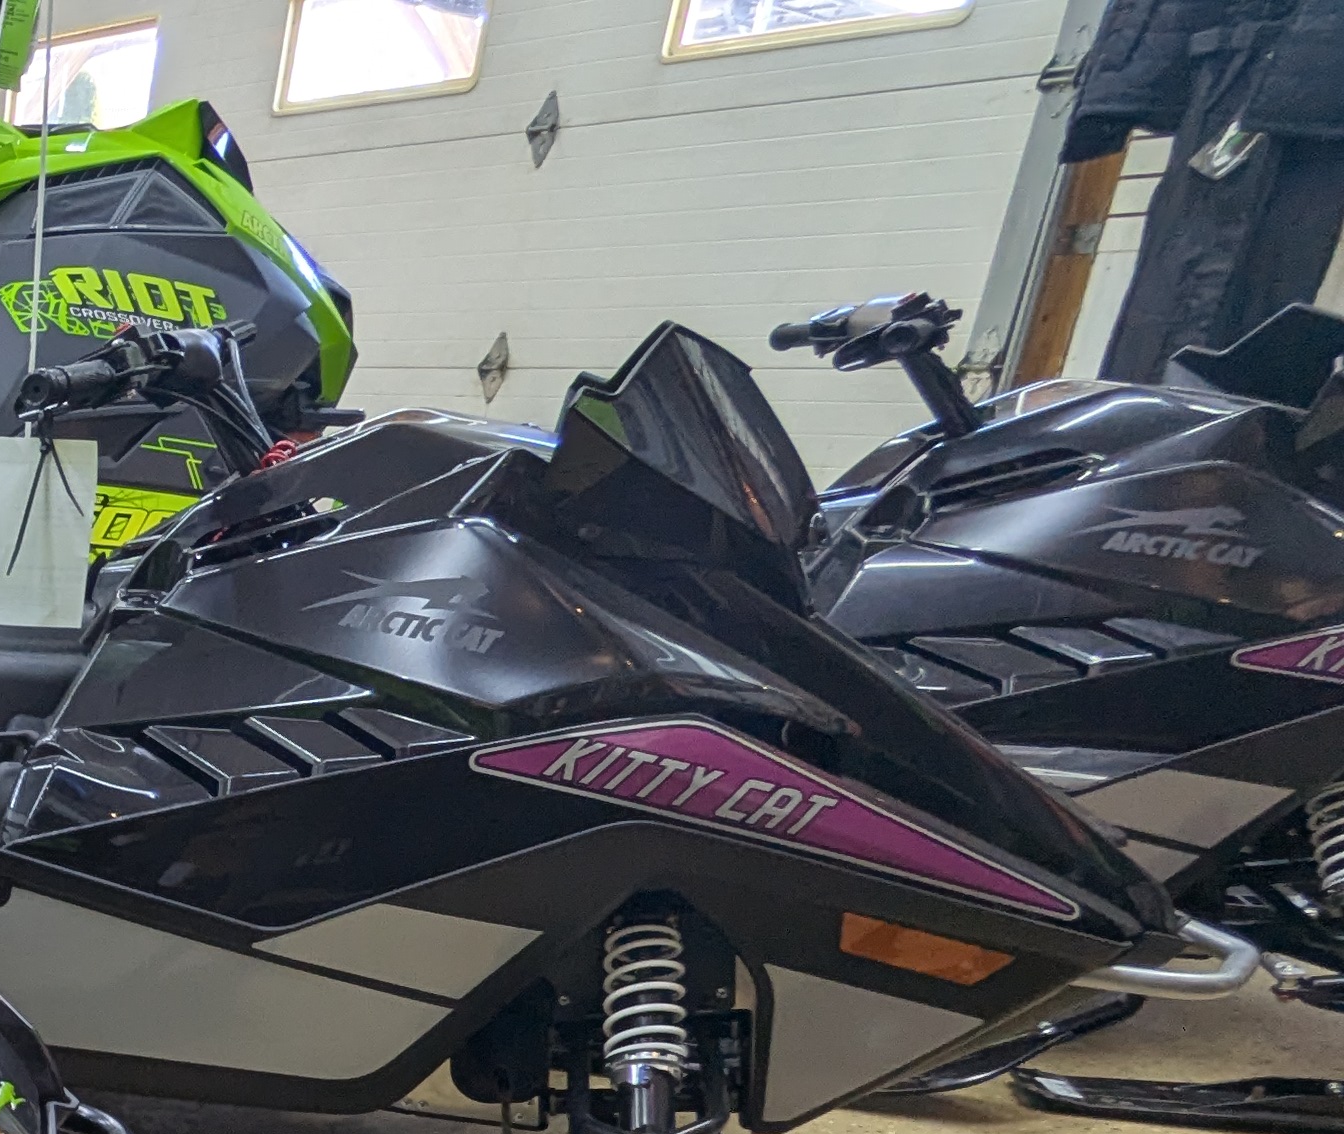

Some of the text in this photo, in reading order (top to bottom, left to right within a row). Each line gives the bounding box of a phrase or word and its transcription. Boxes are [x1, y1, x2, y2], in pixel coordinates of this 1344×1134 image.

[49, 266, 216, 328] RIOT
[1102, 531, 1263, 568] ARCTIC CAT
[338, 604, 506, 654] ARCTIC CAT
[543, 738, 839, 836] KITTY CAT
